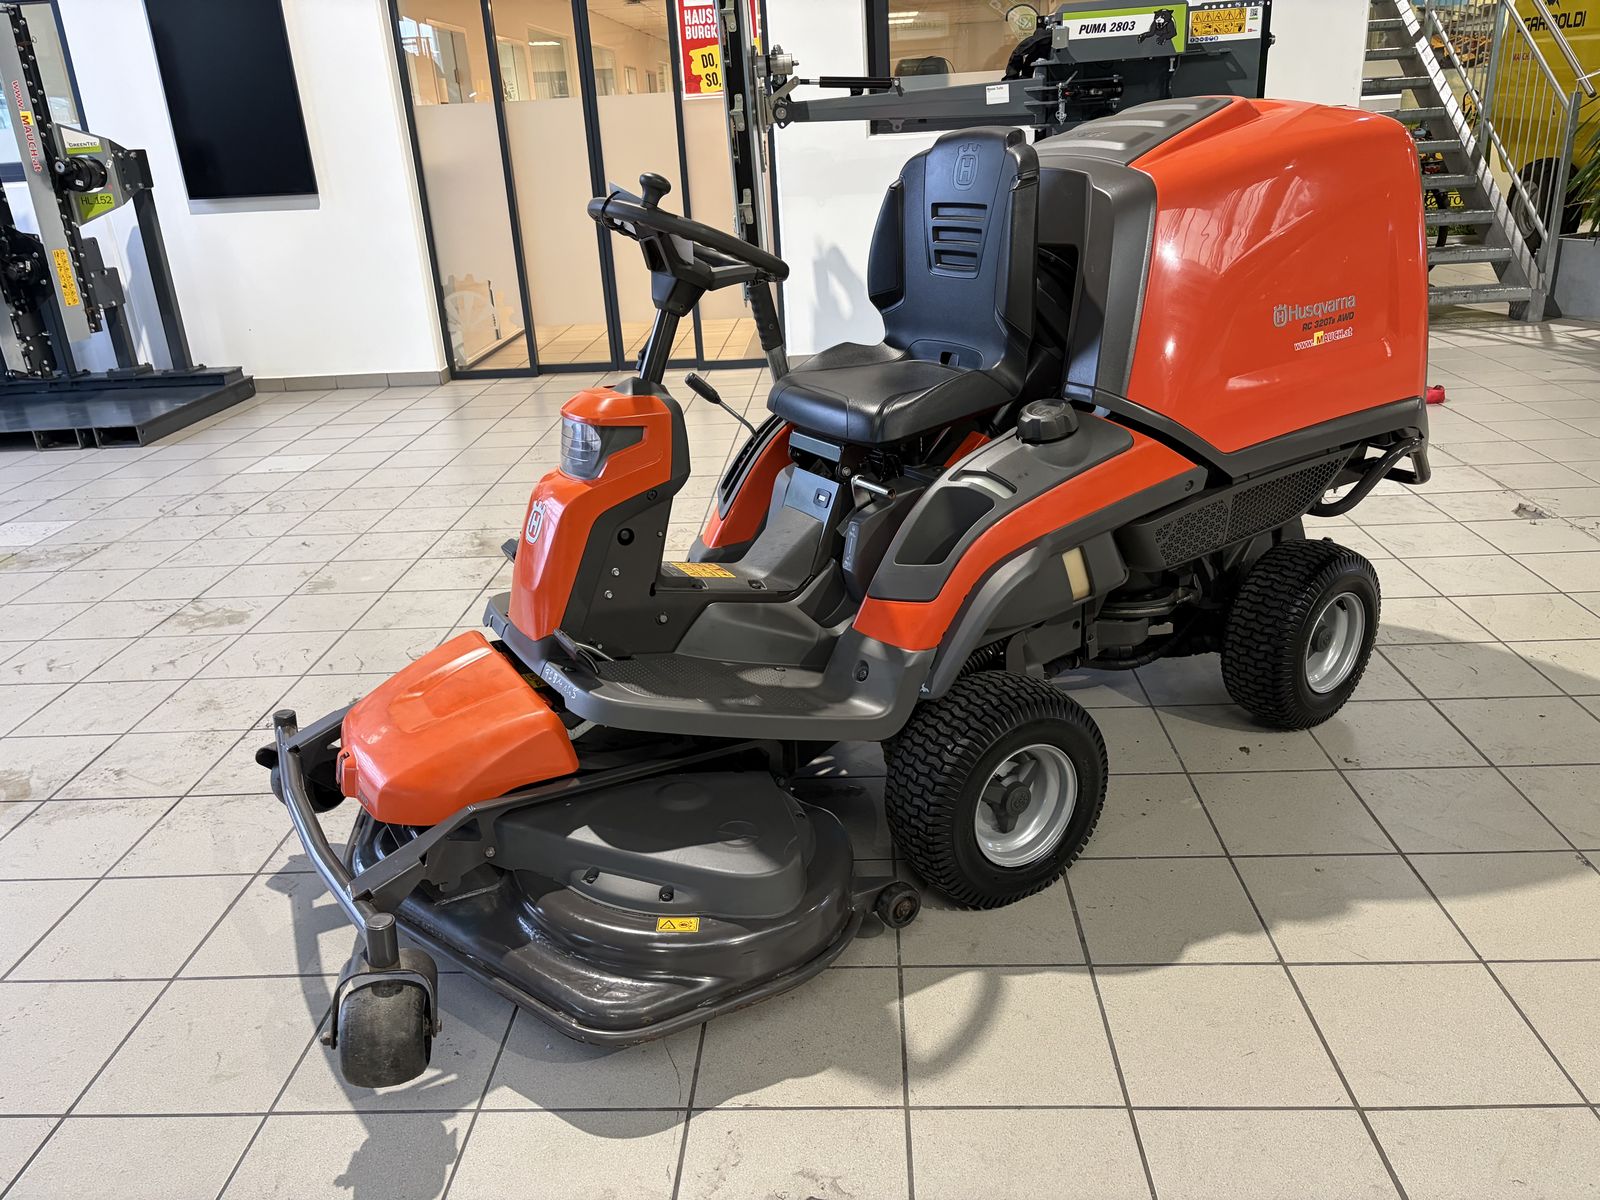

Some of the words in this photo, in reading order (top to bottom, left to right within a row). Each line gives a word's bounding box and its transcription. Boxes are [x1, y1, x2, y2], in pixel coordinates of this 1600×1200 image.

[1078, 22, 1107, 35] PUMA
[1109, 20, 1136, 33] 2803
[701, 53, 718, 69] DO,
[705, 72, 722, 87] SO,
[11, 80, 43, 172] www.MAUCH.at
[80, 197, 93, 205] HL
[94, 196, 113, 205] 152
[1288, 295, 1356, 321] Husqvarna
[1302, 322, 1312, 332] RC
[1336, 311, 1355, 323] AWD
[1293, 326, 1353, 351] www.MAUCH.at
